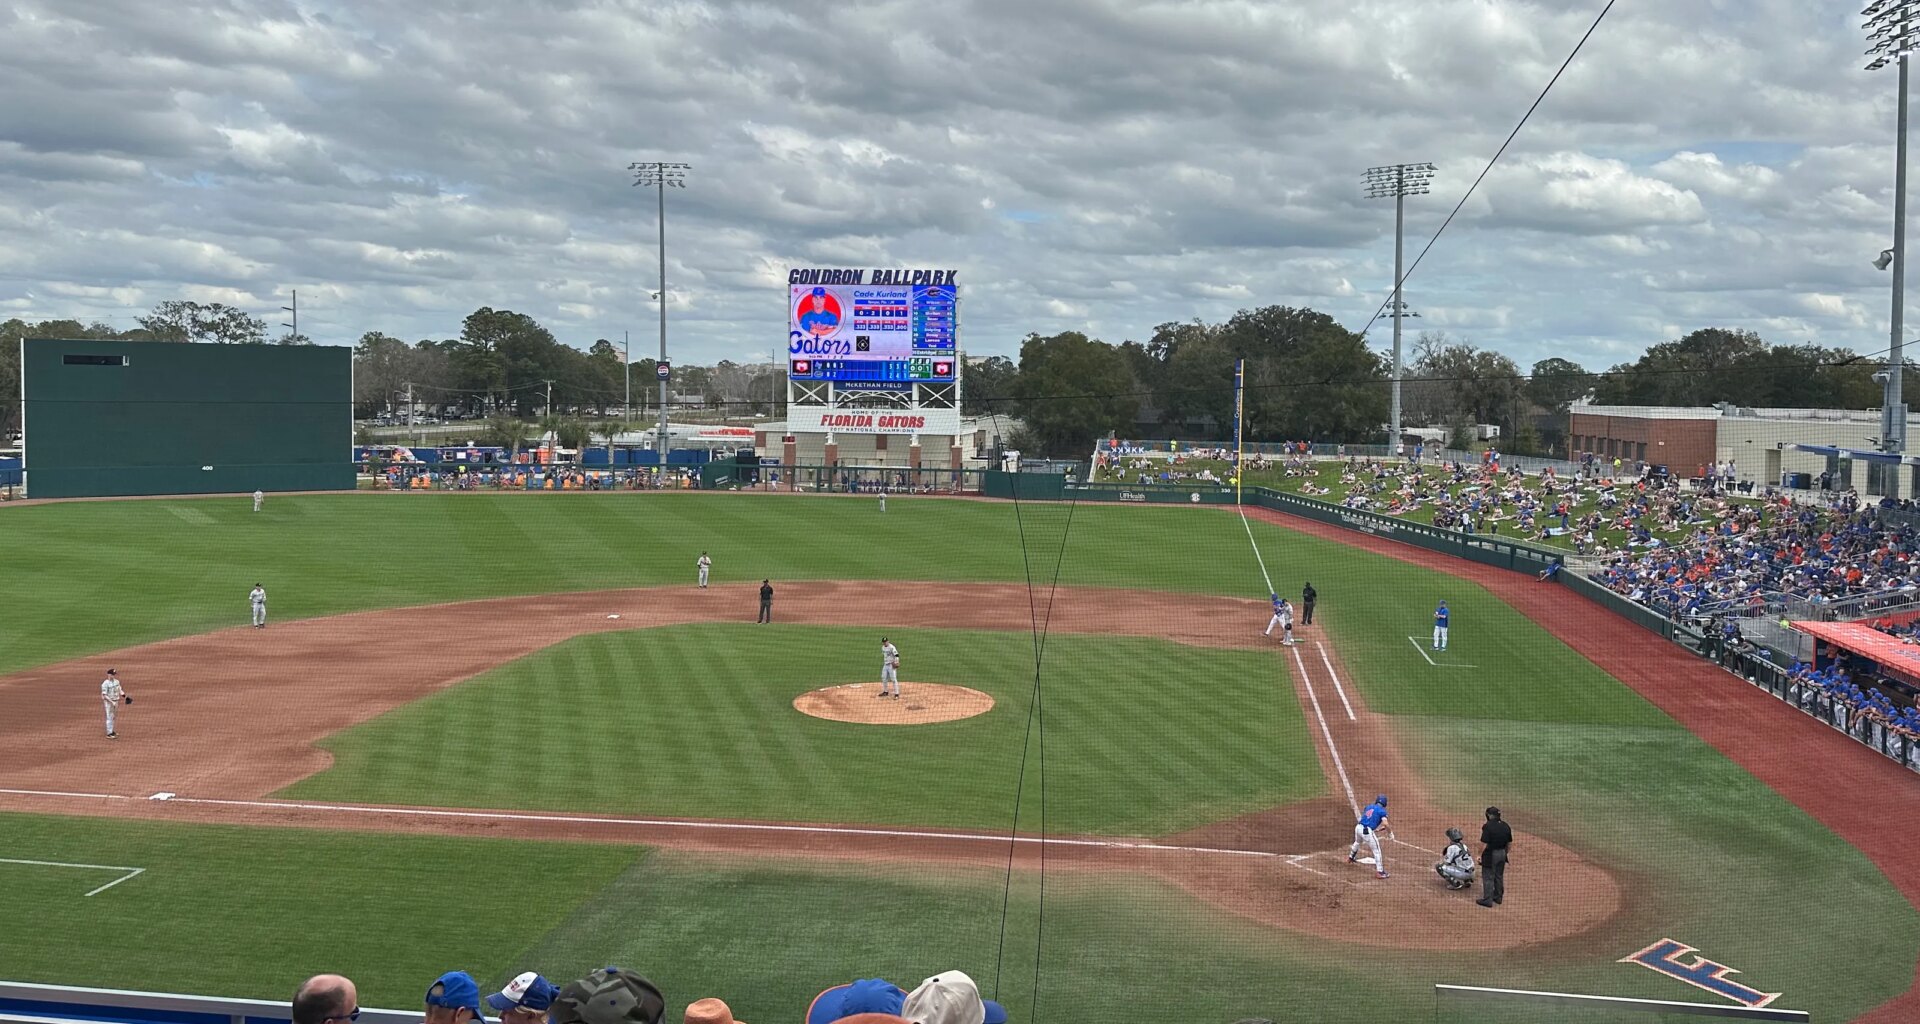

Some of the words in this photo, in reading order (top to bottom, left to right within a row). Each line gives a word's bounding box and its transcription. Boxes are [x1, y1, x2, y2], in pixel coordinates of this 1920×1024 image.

[788, 269, 864, 285] CONDRON
[870, 270, 957, 285] BALLPARK
[854, 290, 874, 298] Cade
[789, 330, 851, 355] Gators
[820, 415, 872, 427] FLORIDA
[877, 416, 925, 428] GATORS
[1617, 937, 1782, 1008] F
